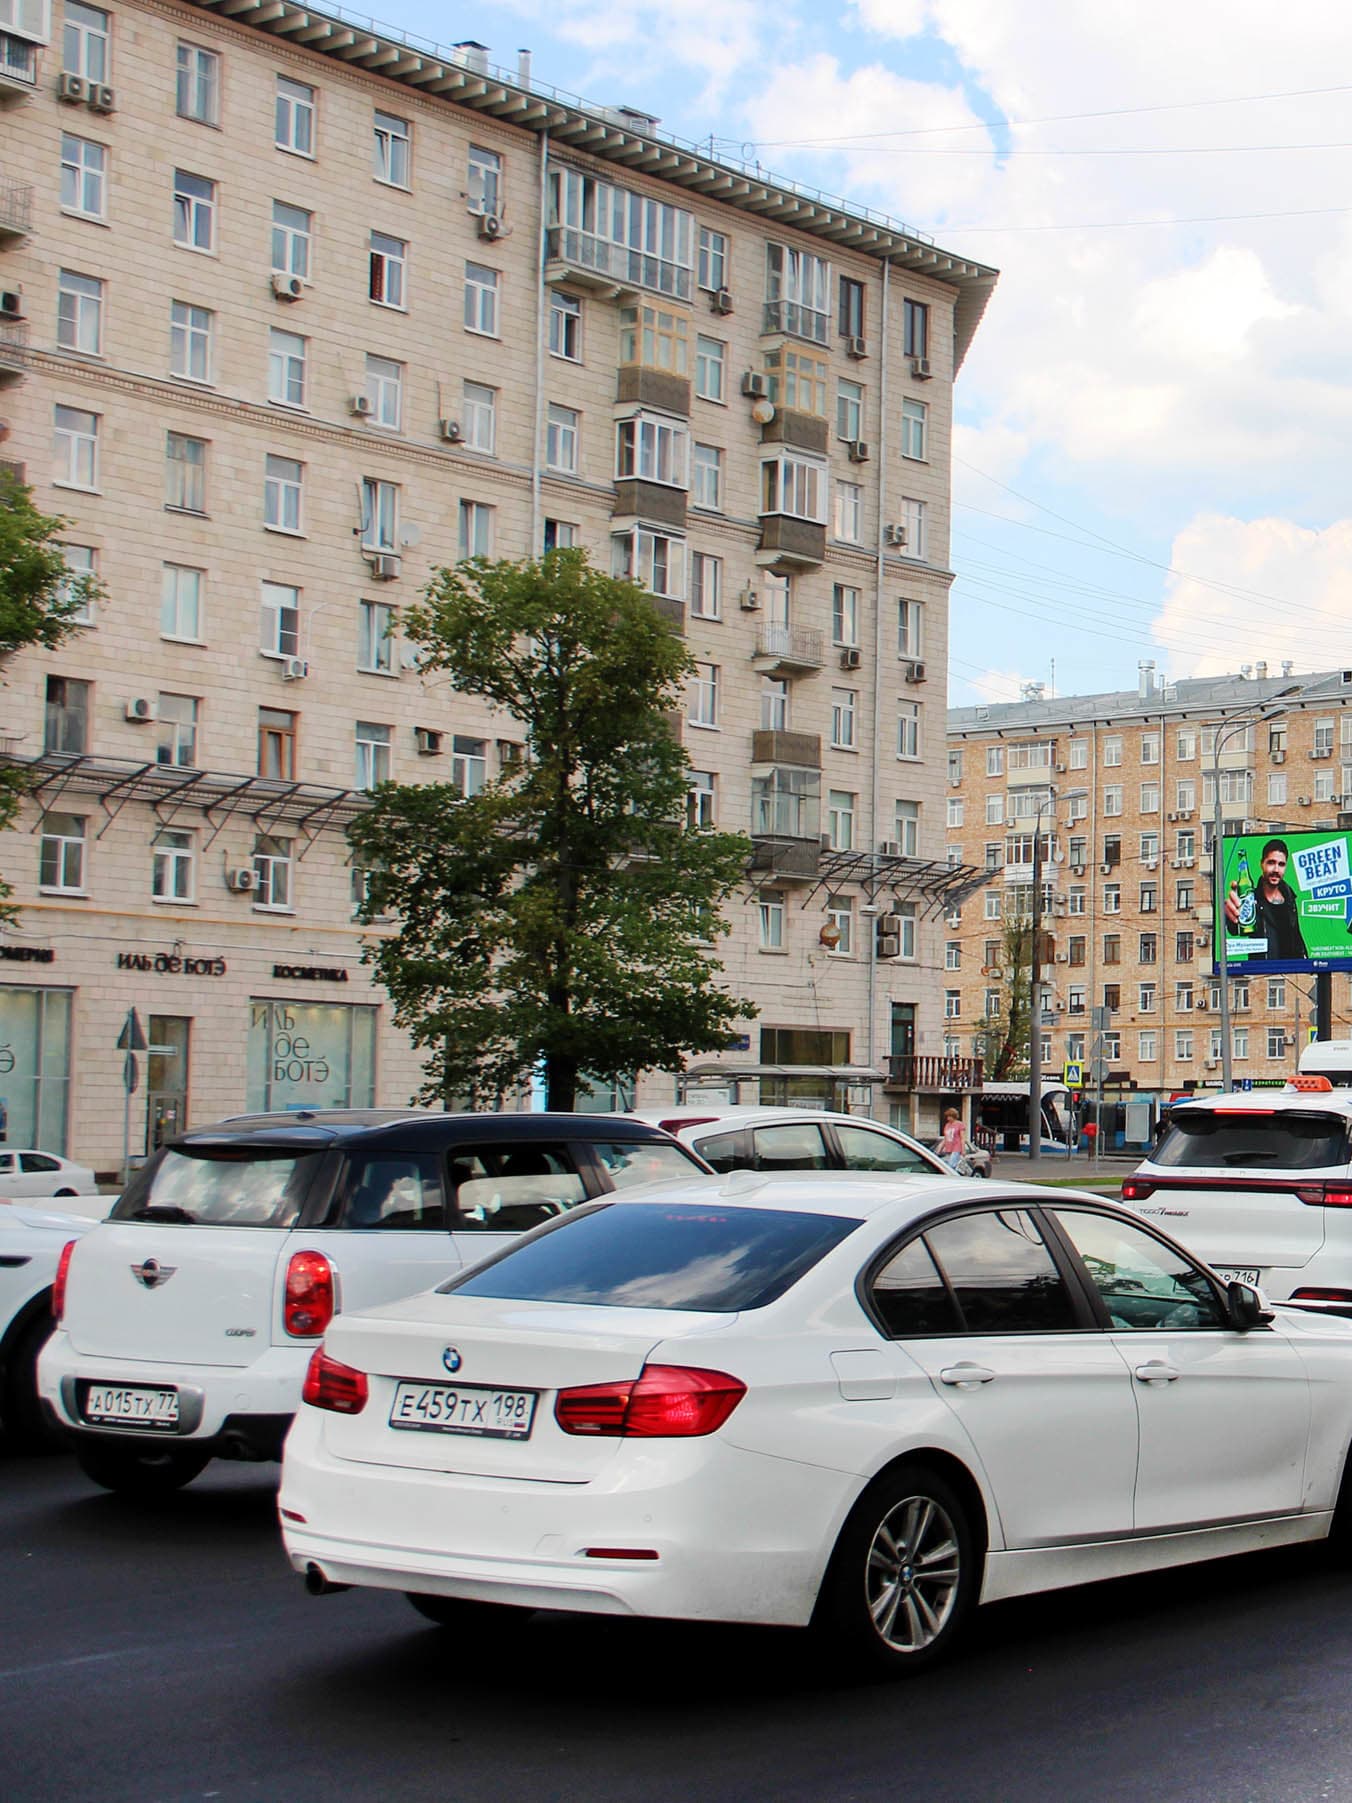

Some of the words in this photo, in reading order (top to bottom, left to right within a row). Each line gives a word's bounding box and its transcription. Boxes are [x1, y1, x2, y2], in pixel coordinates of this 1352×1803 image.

[1299, 845, 1342, 868] GREEN
[1305, 860, 1338, 880] BEAT
[1316, 883, 1347, 897] КРУТО
[1307, 903, 1340, 912] ЗВУЧИТ
[118, 953, 152, 971] ИЛЬ
[273, 965, 348, 982] КОСМЕТИКА
[251, 1007, 295, 1031] ИЛЬ
[1234, 1271, 1255, 1283] 716
[159, 1393, 175, 1410] 77
[494, 1394, 526, 1418] 198
